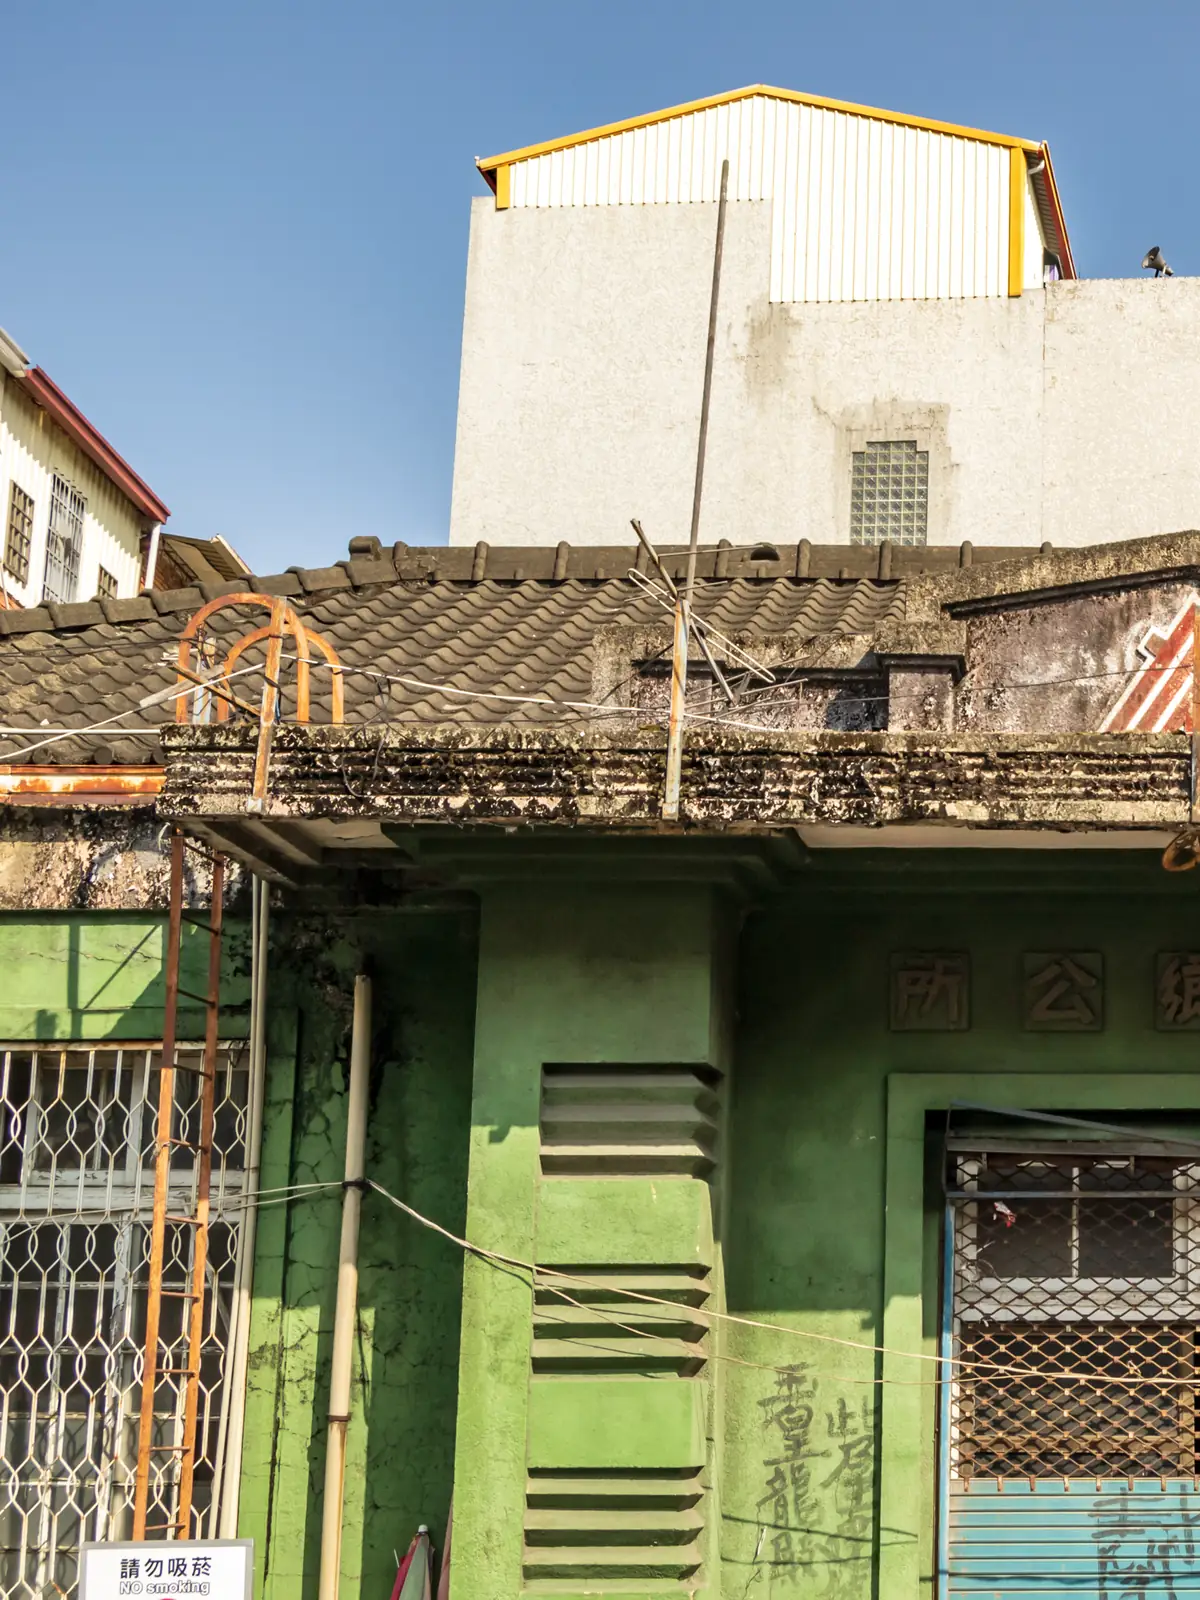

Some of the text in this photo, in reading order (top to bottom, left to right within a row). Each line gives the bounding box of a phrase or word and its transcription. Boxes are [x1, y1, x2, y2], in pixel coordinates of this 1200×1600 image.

[120, 1556, 212, 1579] 請勿吸菸
[119, 1579, 211, 1596] NO smoking
